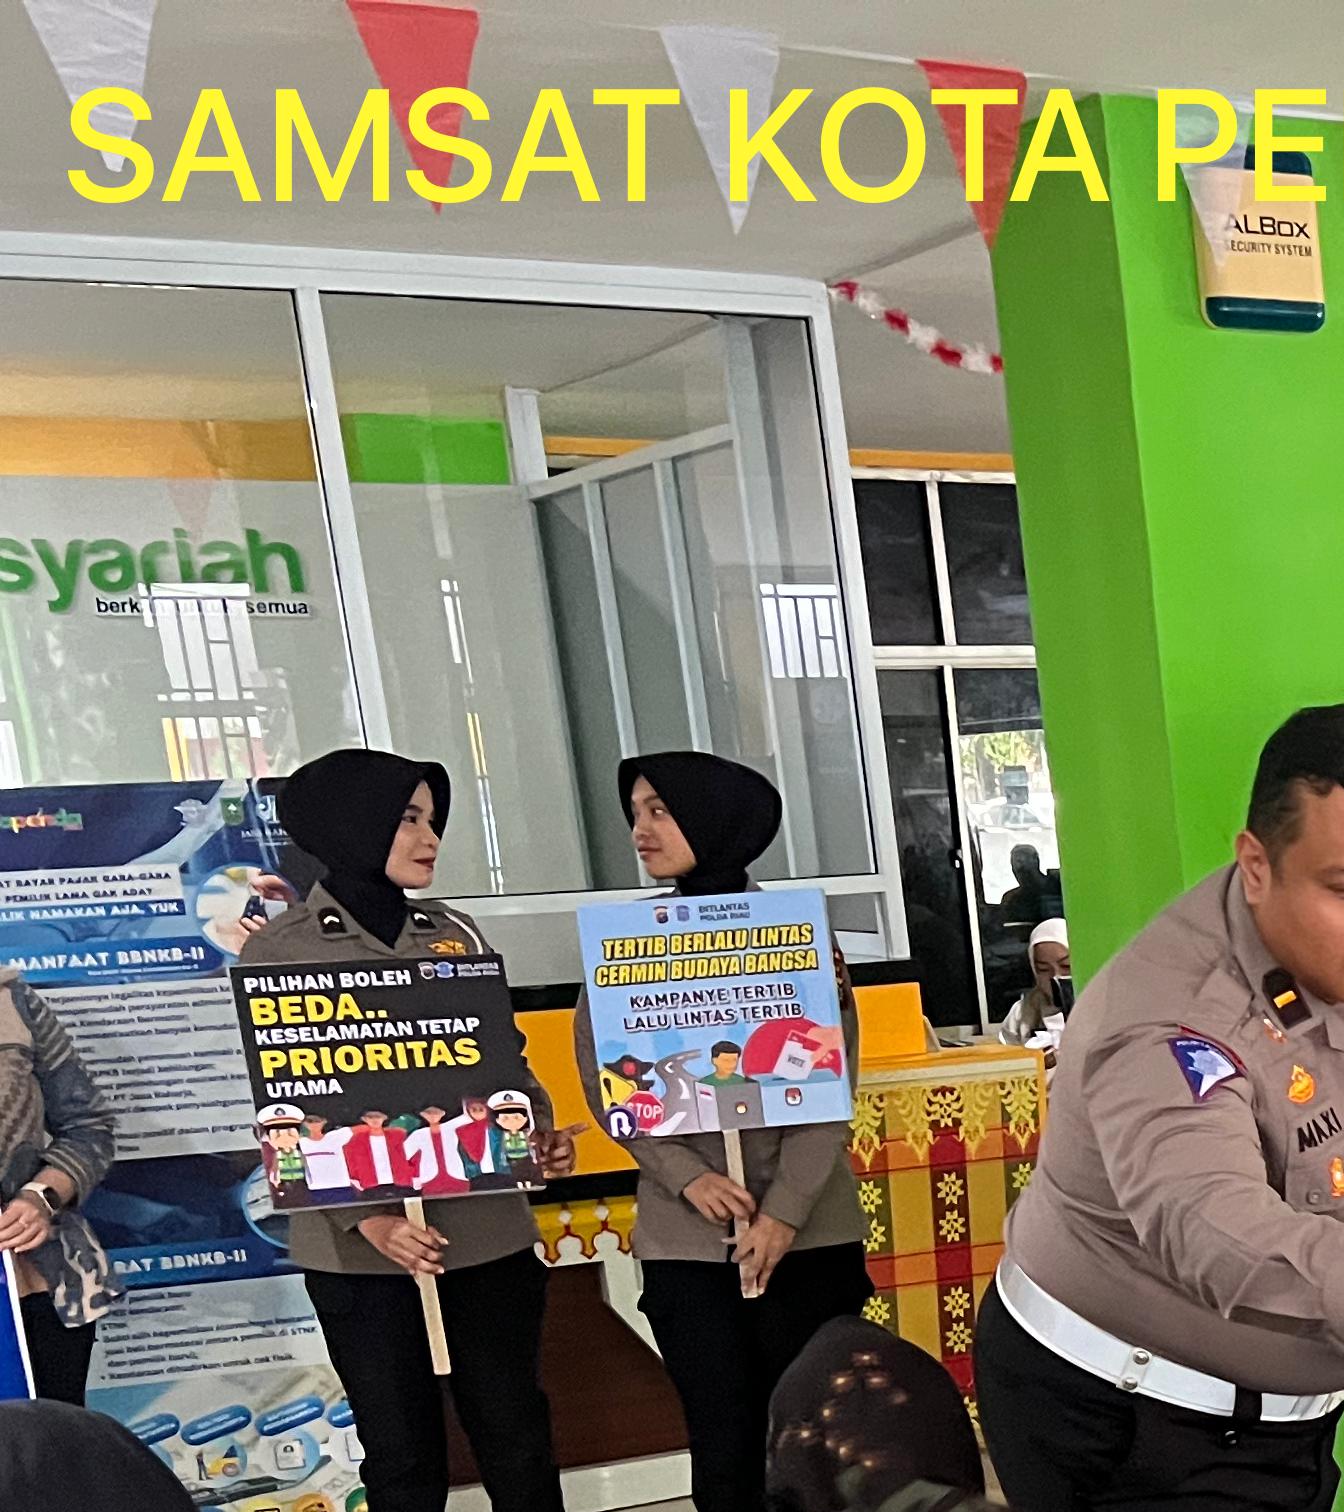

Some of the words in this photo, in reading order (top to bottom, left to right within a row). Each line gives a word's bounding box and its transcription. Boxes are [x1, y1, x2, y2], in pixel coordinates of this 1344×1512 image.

[1230, 240, 1272, 254] ECURITY
[1275, 244, 1312, 257] SYSTEM
[0, 527, 305, 612] syariah
[246, 600, 309, 614] semua
[149, 902, 179, 914] YUK
[602, 935, 666, 960] TERTIB
[669, 929, 750, 954] BERLALU
[751, 923, 813, 948] LINTAS
[244, 973, 335, 993] PILIHAN
[339, 969, 412, 988] BOLEH
[595, 961, 668, 987] CERMIN
[669, 955, 741, 980] BUDAYA
[744, 949, 819, 974] BANGSA
[249, 992, 388, 1026] BEDA..
[629, 987, 729, 1011] KAMPANYE
[732, 982, 797, 1002] TERTIB
[254, 1020, 414, 1045] KESELAMATAN
[417, 1016, 480, 1035] TETAP
[623, 1016, 671, 1033] LALU
[673, 1008, 738, 1028] LINTAS
[741, 1003, 805, 1023] TERTIB
[259, 1038, 482, 1078] PRIORITAS
[266, 1078, 344, 1098] UTAMA
[627, 1101, 662, 1119] STOP
[1297, 1107, 1343, 1152] MAXI
